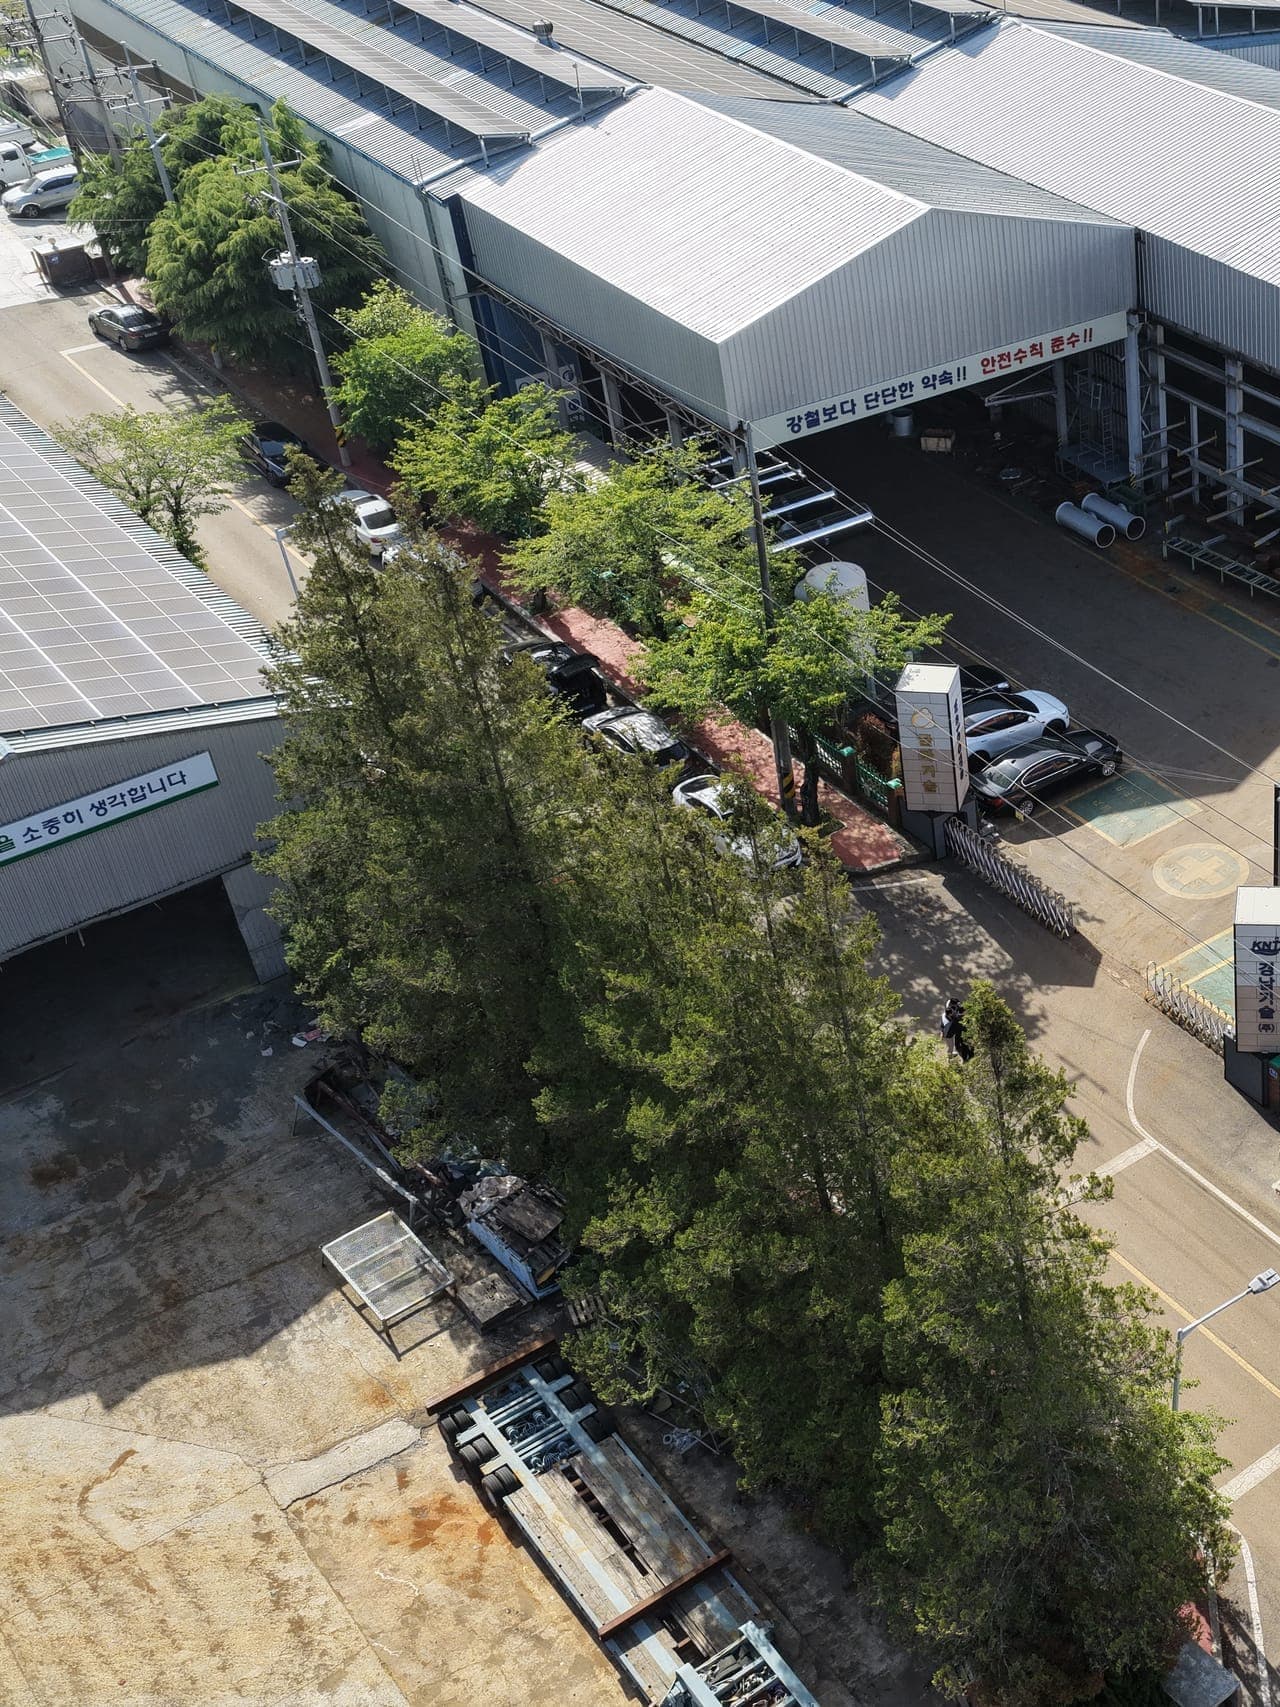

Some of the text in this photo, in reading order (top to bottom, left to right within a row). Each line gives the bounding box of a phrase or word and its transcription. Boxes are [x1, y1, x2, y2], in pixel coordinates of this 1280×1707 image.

[786, 327, 1093, 434] 강철보다 단단한 약속!! 안전수칙 준수!!
[22, 808, 84, 844] 소중히
[89, 769, 187, 818] 생각합니다
